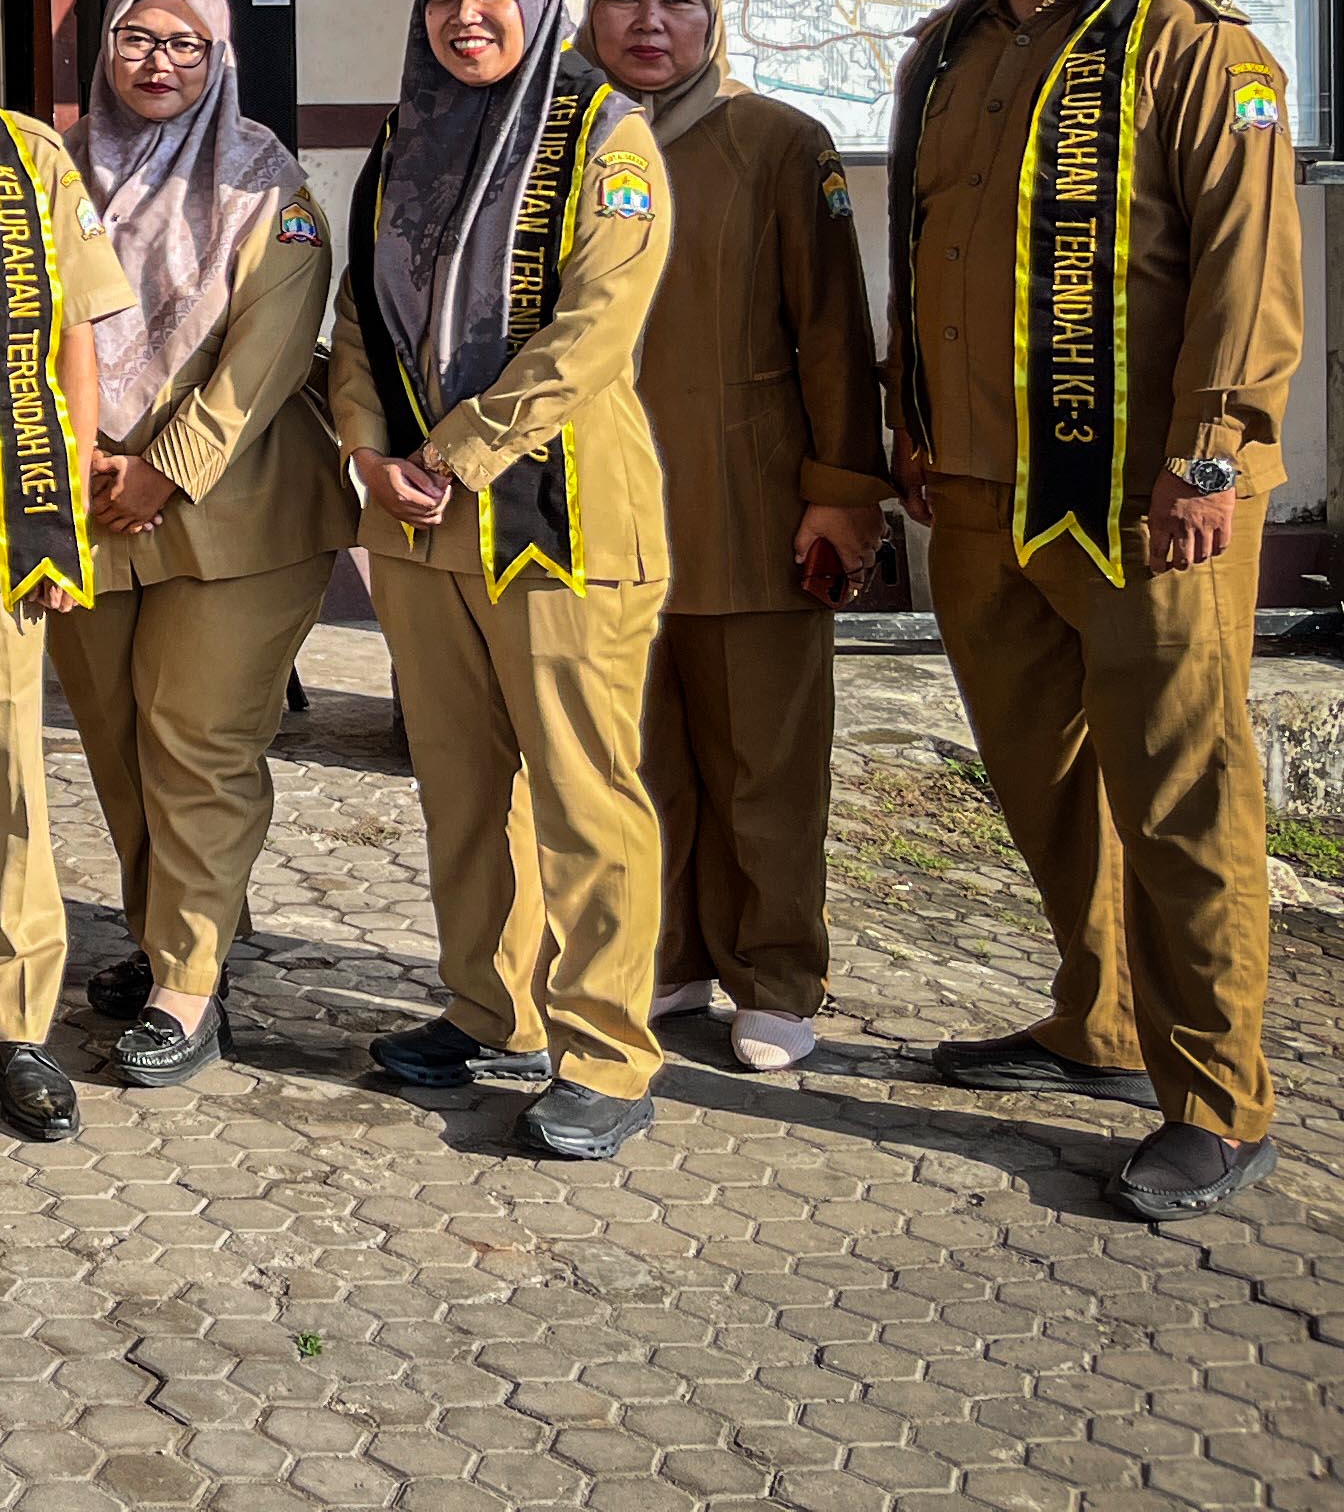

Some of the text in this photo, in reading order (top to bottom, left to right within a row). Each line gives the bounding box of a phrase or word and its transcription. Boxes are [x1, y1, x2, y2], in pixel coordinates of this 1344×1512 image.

[1052, 48, 1106, 443] KELURAHAN TERENDAH KE-3
[6, 328, 50, 457] TERENDAH
[19, 461, 58, 514] KE-1
